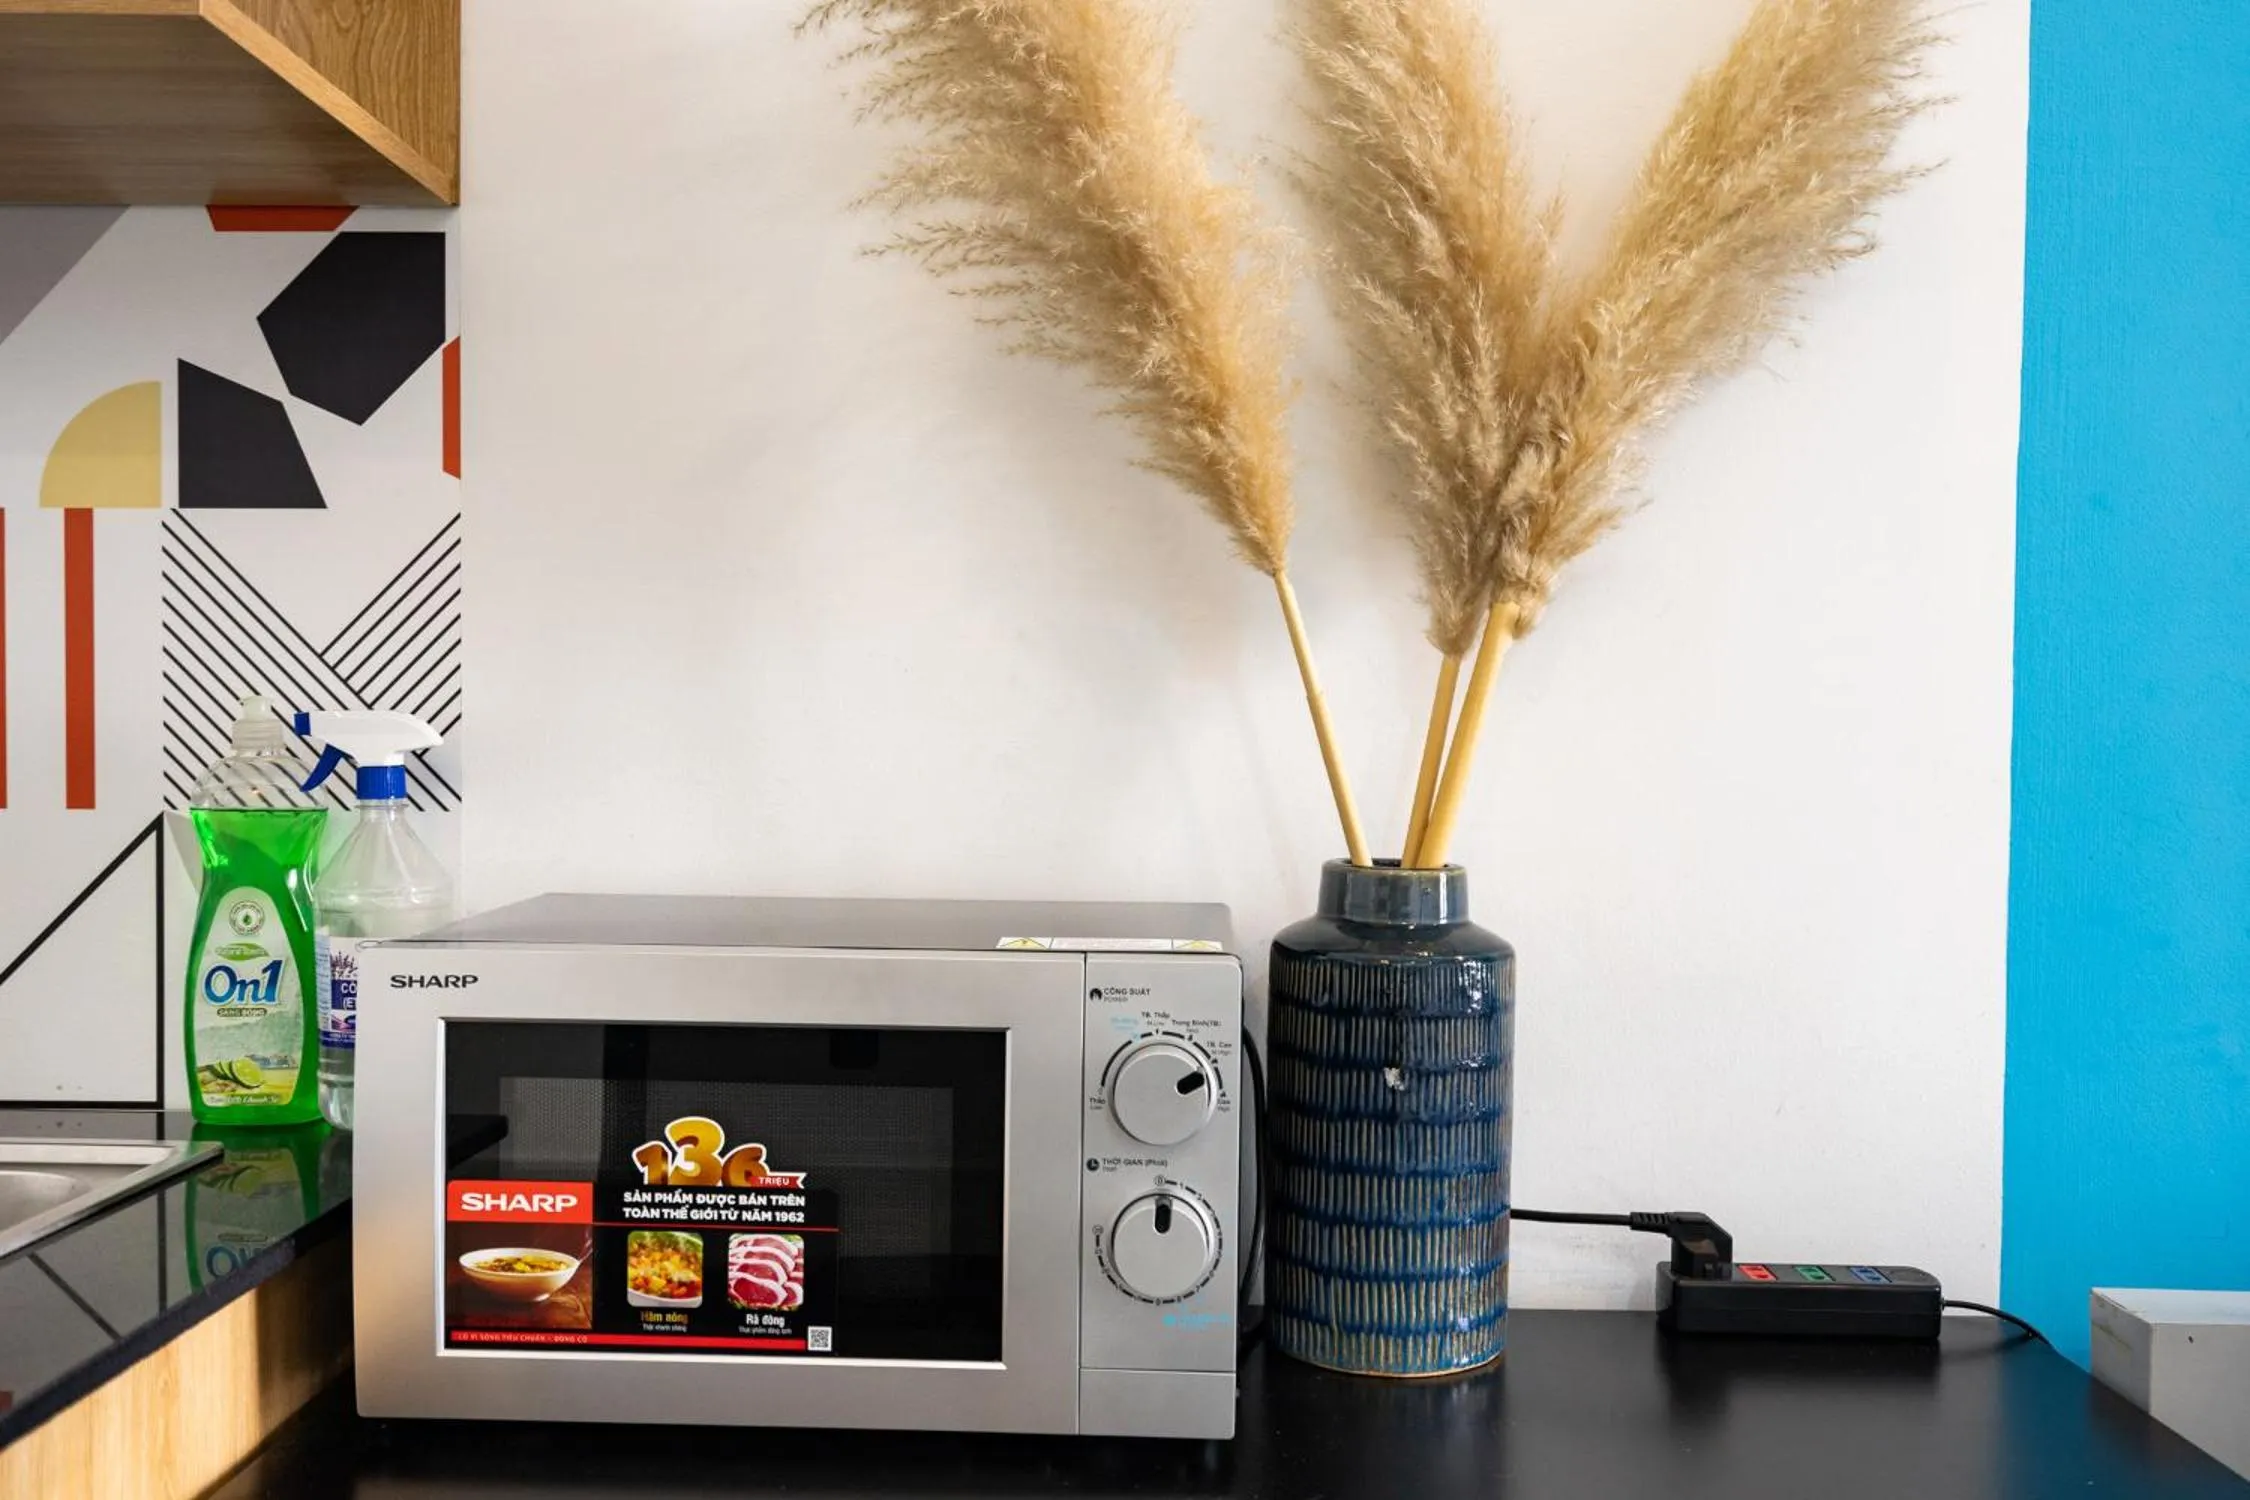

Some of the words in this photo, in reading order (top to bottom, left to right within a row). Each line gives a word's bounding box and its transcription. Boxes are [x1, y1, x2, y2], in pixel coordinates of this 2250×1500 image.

[203, 959, 284, 1004] On1
[390, 974, 479, 989] SHARP
[632, 1116, 769, 1187] 136
[758, 1176, 790, 1187] TRIỆU
[461, 1192, 578, 1213] SHARP
[696, 1192, 736, 1208] ĐƯỢC
[738, 1191, 768, 1206] BÁN
[769, 1193, 806, 1207] TRÊN
[622, 1204, 661, 1219] TOÀN
[661, 1204, 690, 1220] THẾ
[689, 1206, 718, 1221] GIỚI
[719, 1207, 740, 1221] TỪ
[741, 1209, 772, 1222] NĂM
[774, 1211, 805, 1224] 1962
